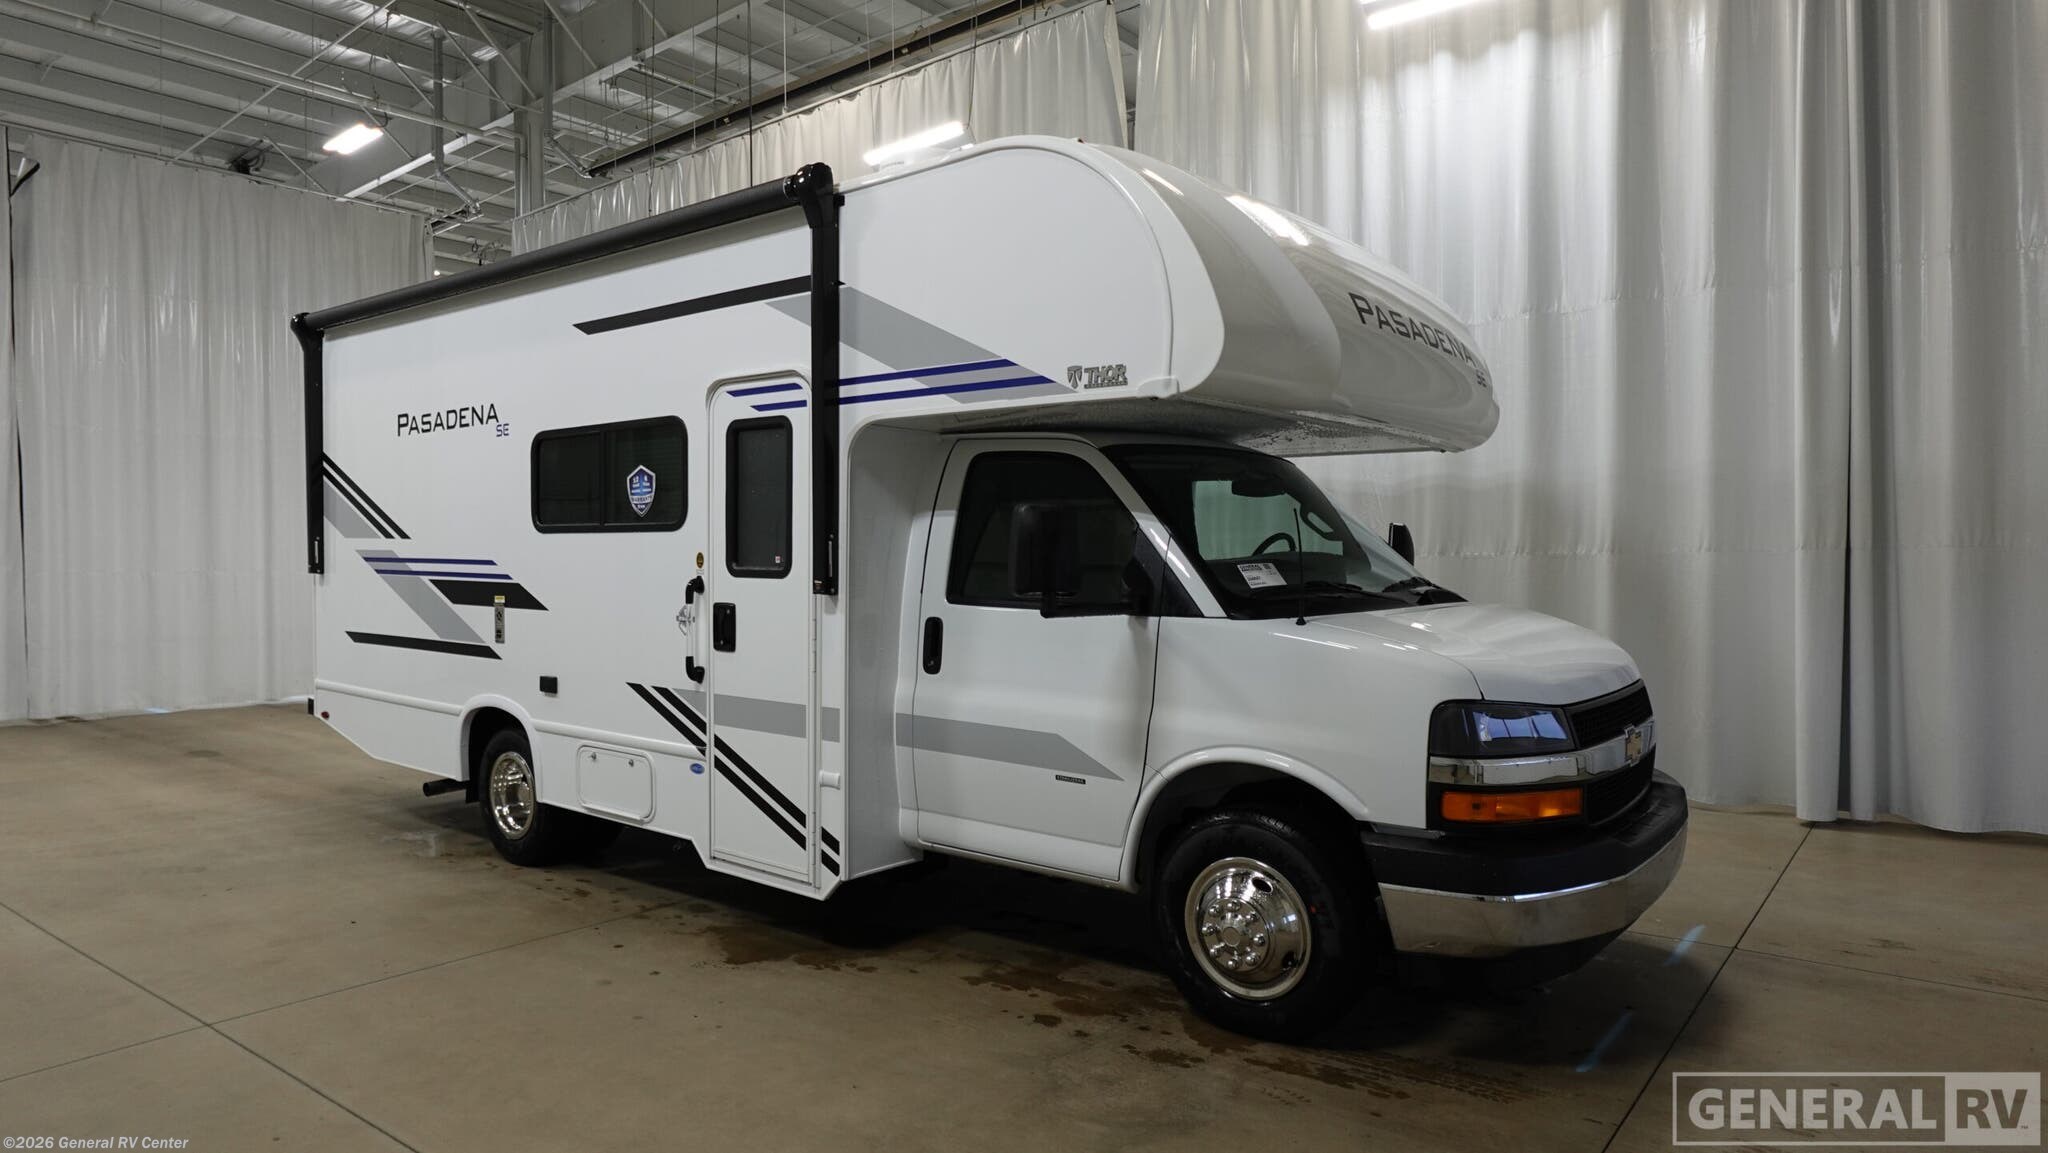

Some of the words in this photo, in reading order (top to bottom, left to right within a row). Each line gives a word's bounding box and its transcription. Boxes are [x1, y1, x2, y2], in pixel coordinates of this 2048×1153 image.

[1348, 291, 1476, 367] PASADENA
[1084, 364, 1128, 384] THOR
[397, 403, 499, 437] PASADENA
[496, 423, 510, 437] SE
